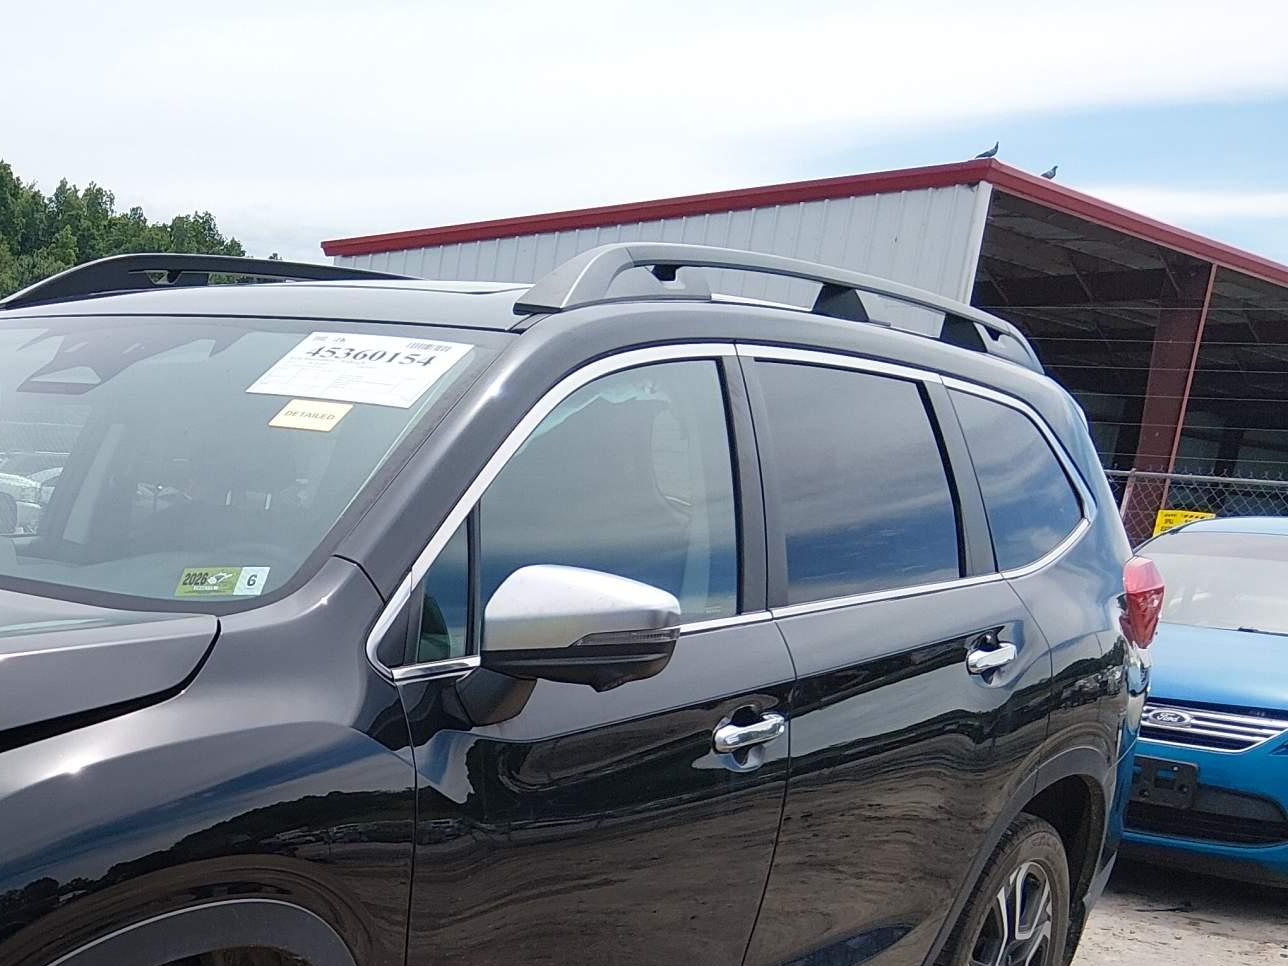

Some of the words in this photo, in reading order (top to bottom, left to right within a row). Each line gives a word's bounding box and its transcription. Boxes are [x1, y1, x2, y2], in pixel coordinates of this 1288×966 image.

[305, 345, 437, 367] 45360154
[283, 408, 336, 421] DETAILED
[182, 572, 209, 586] 2026
[246, 573, 258, 587] 6
